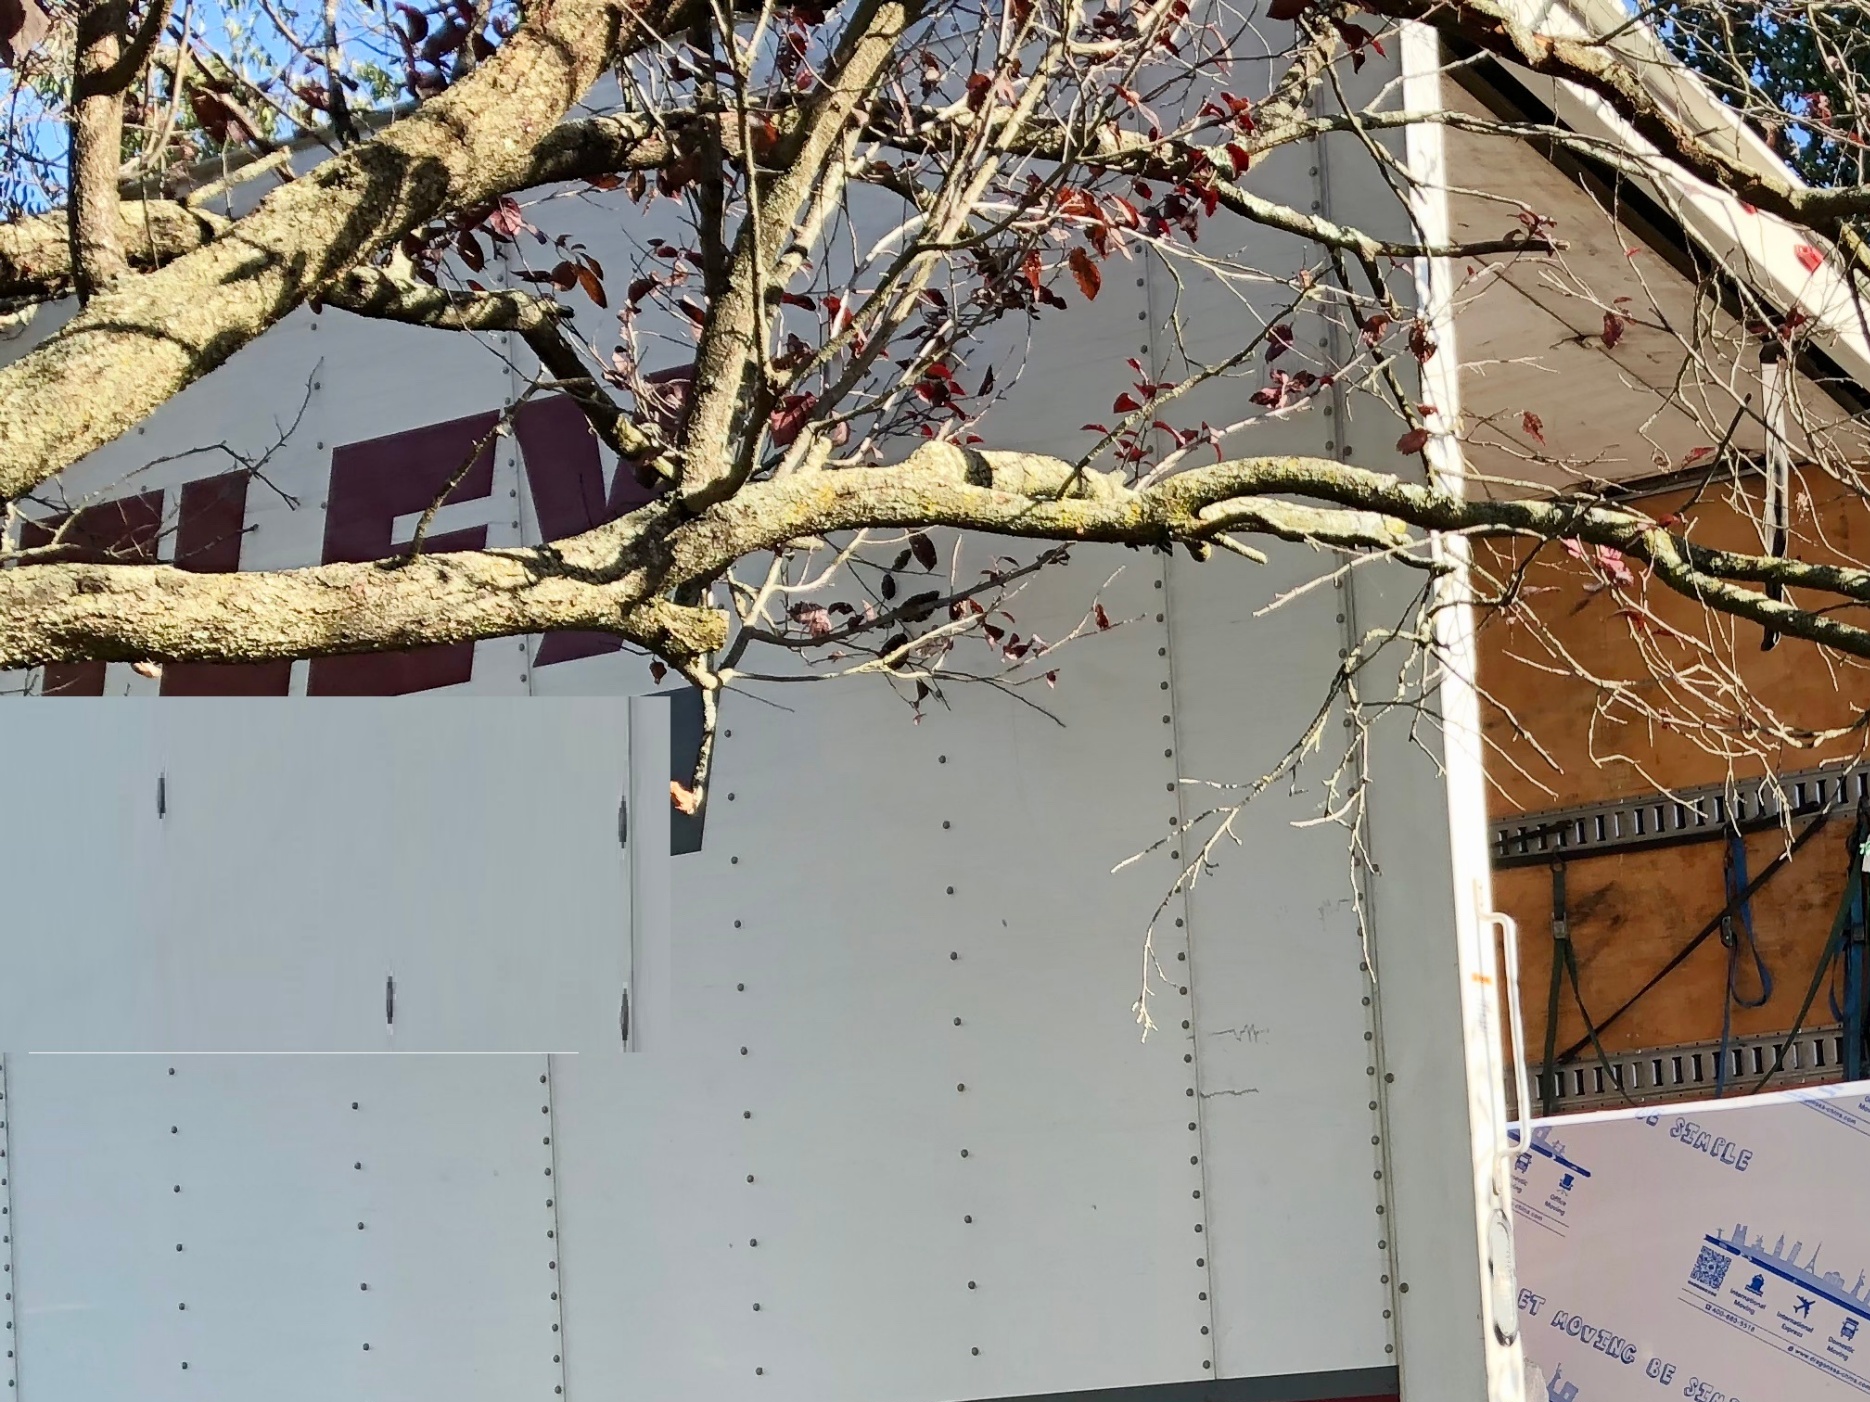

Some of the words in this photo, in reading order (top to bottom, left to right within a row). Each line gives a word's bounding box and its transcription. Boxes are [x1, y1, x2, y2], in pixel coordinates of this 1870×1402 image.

[1670, 1117, 1753, 1171] SIMPLE
[1544, 1200, 1566, 1217] Moving
[1549, 1193, 1567, 1207] Office
[1730, 1287, 1766, 1310] International
[1733, 1299, 1756, 1316] Moving
[1776, 1310, 1814, 1333] International
[1780, 1323, 1804, 1338] Express
[1551, 1310, 1637, 1364] MOVING
[1646, 1357, 1676, 1385] BE
[1826, 1345, 1849, 1361] Moving
[1827, 1336, 1855, 1353] Domestic
